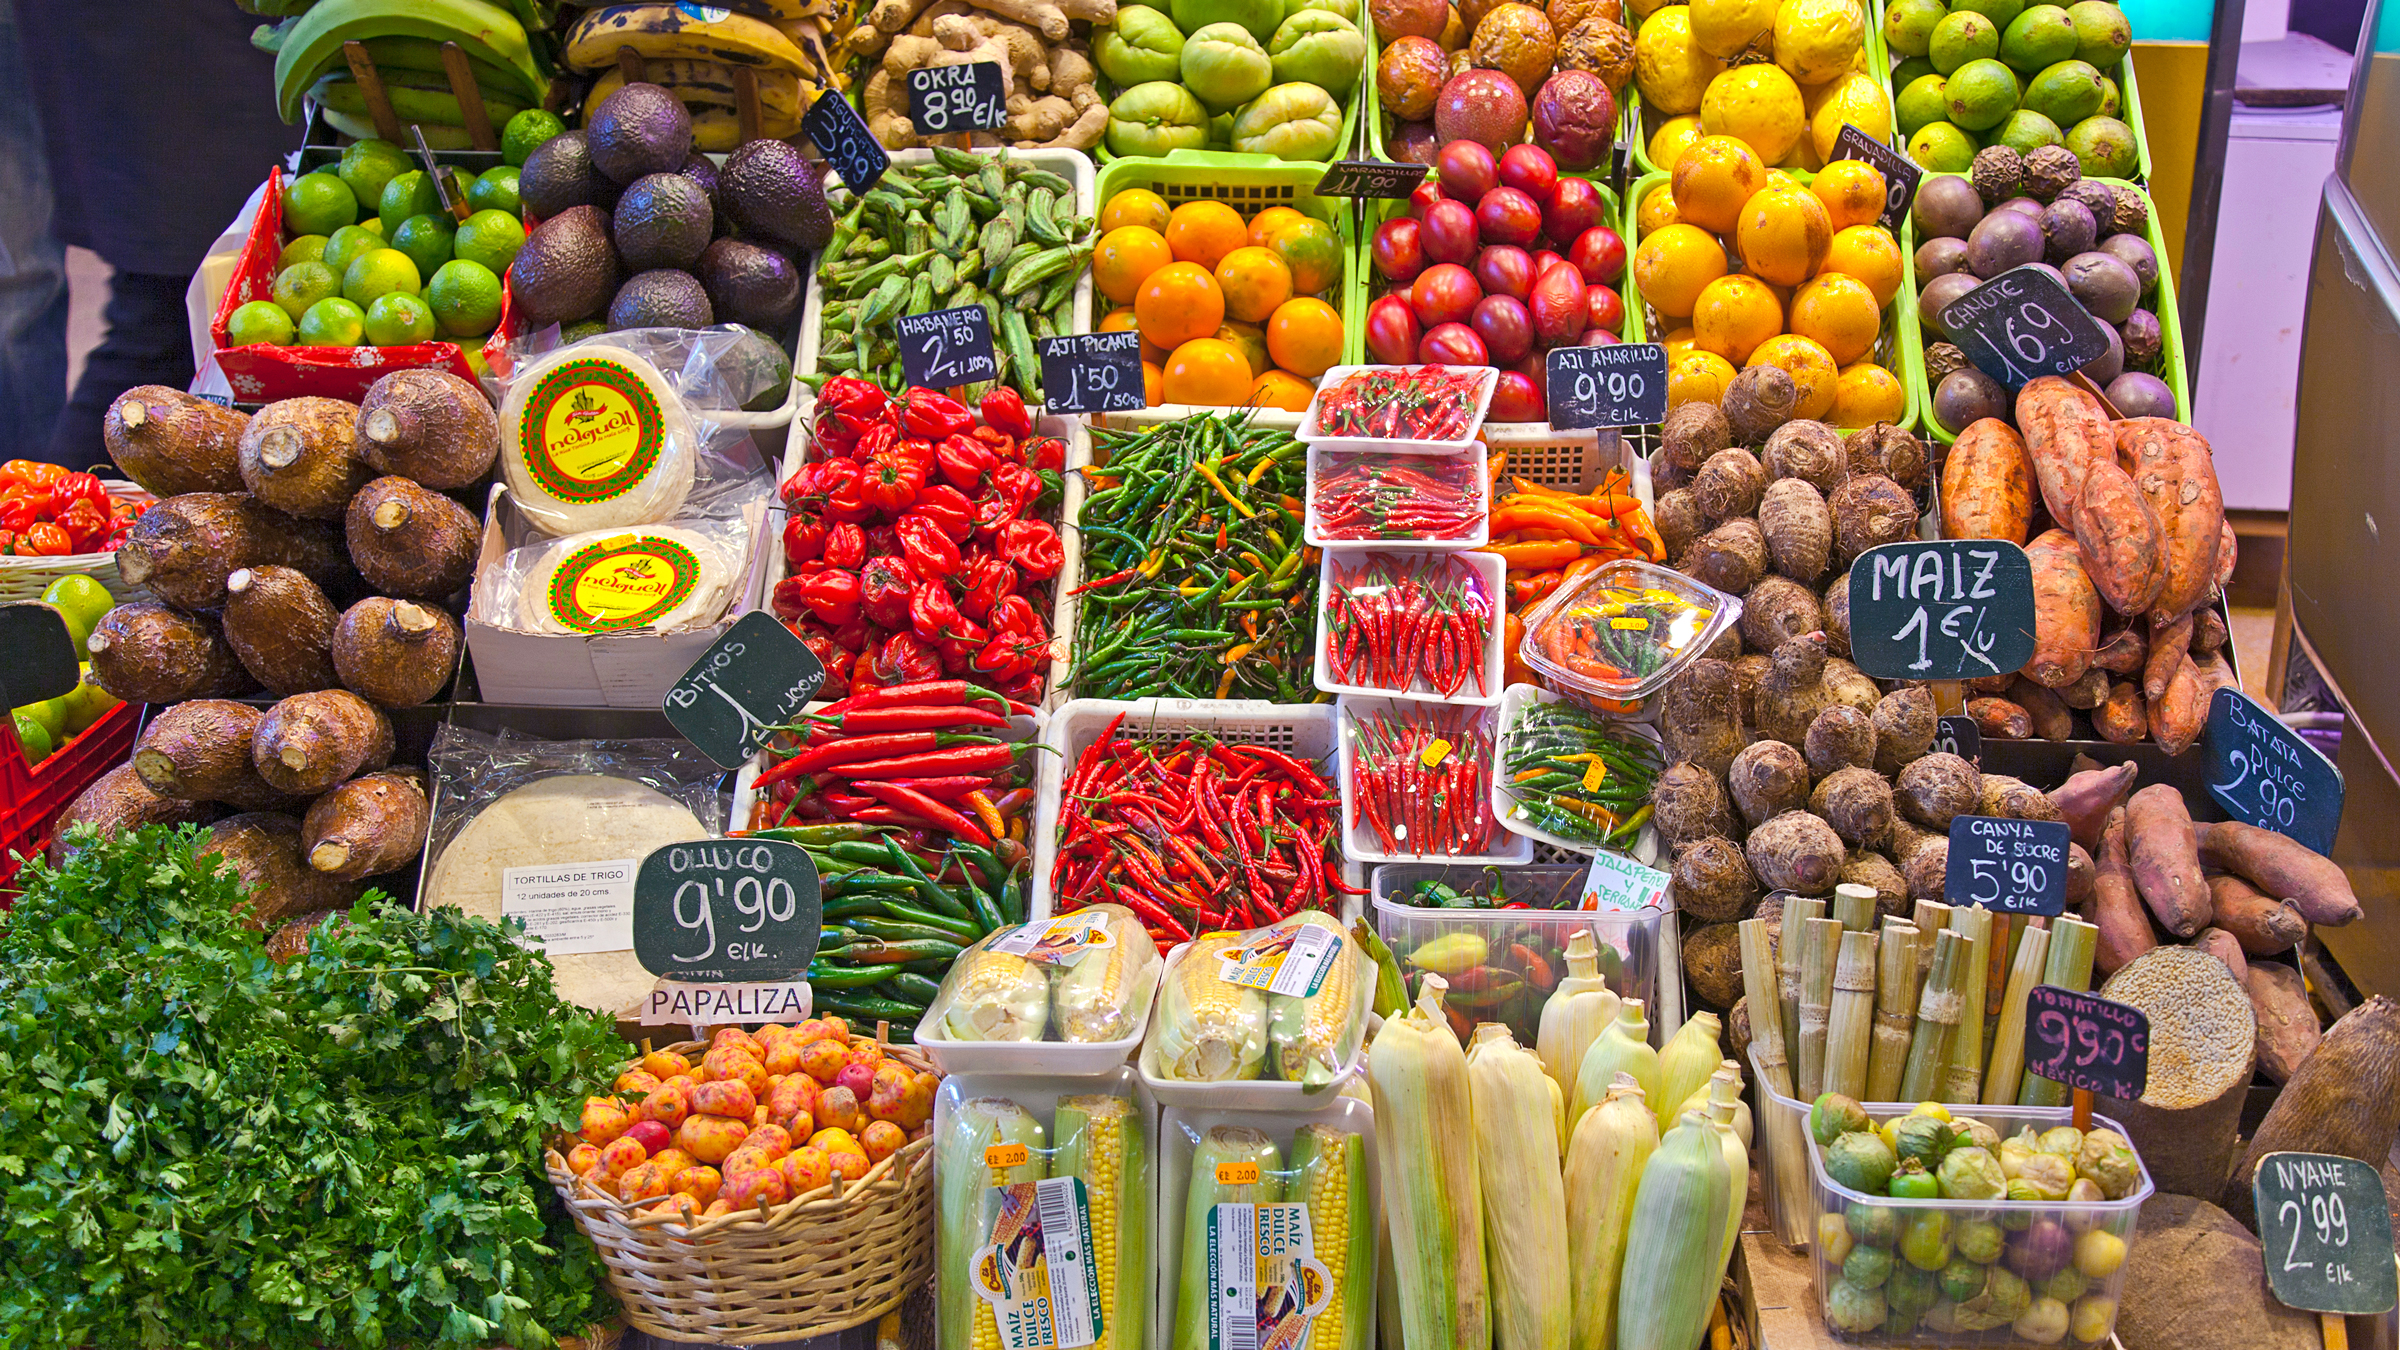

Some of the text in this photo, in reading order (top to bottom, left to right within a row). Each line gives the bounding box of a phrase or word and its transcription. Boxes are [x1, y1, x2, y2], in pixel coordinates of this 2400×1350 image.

[913, 63, 976, 90] OKRA
[827, 94, 884, 171] AGUACATES
[1842, 128, 1912, 182] GRANADILLA
[900, 308, 982, 337] HABANERO
[1080, 332, 1140, 353] PICANTE
[2223, 693, 2303, 769] BATATA
[2250, 743, 2307, 801] DULCE
[1970, 820, 2035, 838] CANYA
[1986, 838, 2061, 862] DE SUCRE
[513, 870, 624, 885] TORTILLAS DE TRIGO
[517, 892, 527, 900] 12
[528, 890, 566, 900] unidades
[568, 889, 579, 898] de
[580, 888, 591, 897] 20
[1969, 859, 2047, 904] 5'90
[651, 987, 803, 1016] PAPALIZA
[2033, 988, 2137, 1028] TOMATILLO
[1005, 1152, 1026, 1164] 2.00
[1236, 1169, 1257, 1181] 2.00
[2275, 1160, 2346, 1191] NYAME
[1079, 1204, 1091, 1244] NATURAL
[1258, 1208, 1270, 1256] FRESCO
[1272, 1208, 1286, 1255] DULCE
[1288, 1207, 1304, 1247] MAÍZ
[2279, 1192, 2350, 1272] 2'99
[988, 1254, 1001, 1292] Campo
[1083, 1245, 1094, 1265] MÁS
[1087, 1266, 1099, 1307] ELECCIÓN
[1209, 1225, 1219, 1340] LA ELECCIÓN MÁS NATURAL
[1303, 1268, 1316, 1305] Campo
[1007, 1310, 1024, 1349] MAÍZ
[1022, 1299, 1040, 1348] DULCE
[1036, 1297, 1054, 1346] FRESCO
[1092, 1307, 1100, 1320] LA
